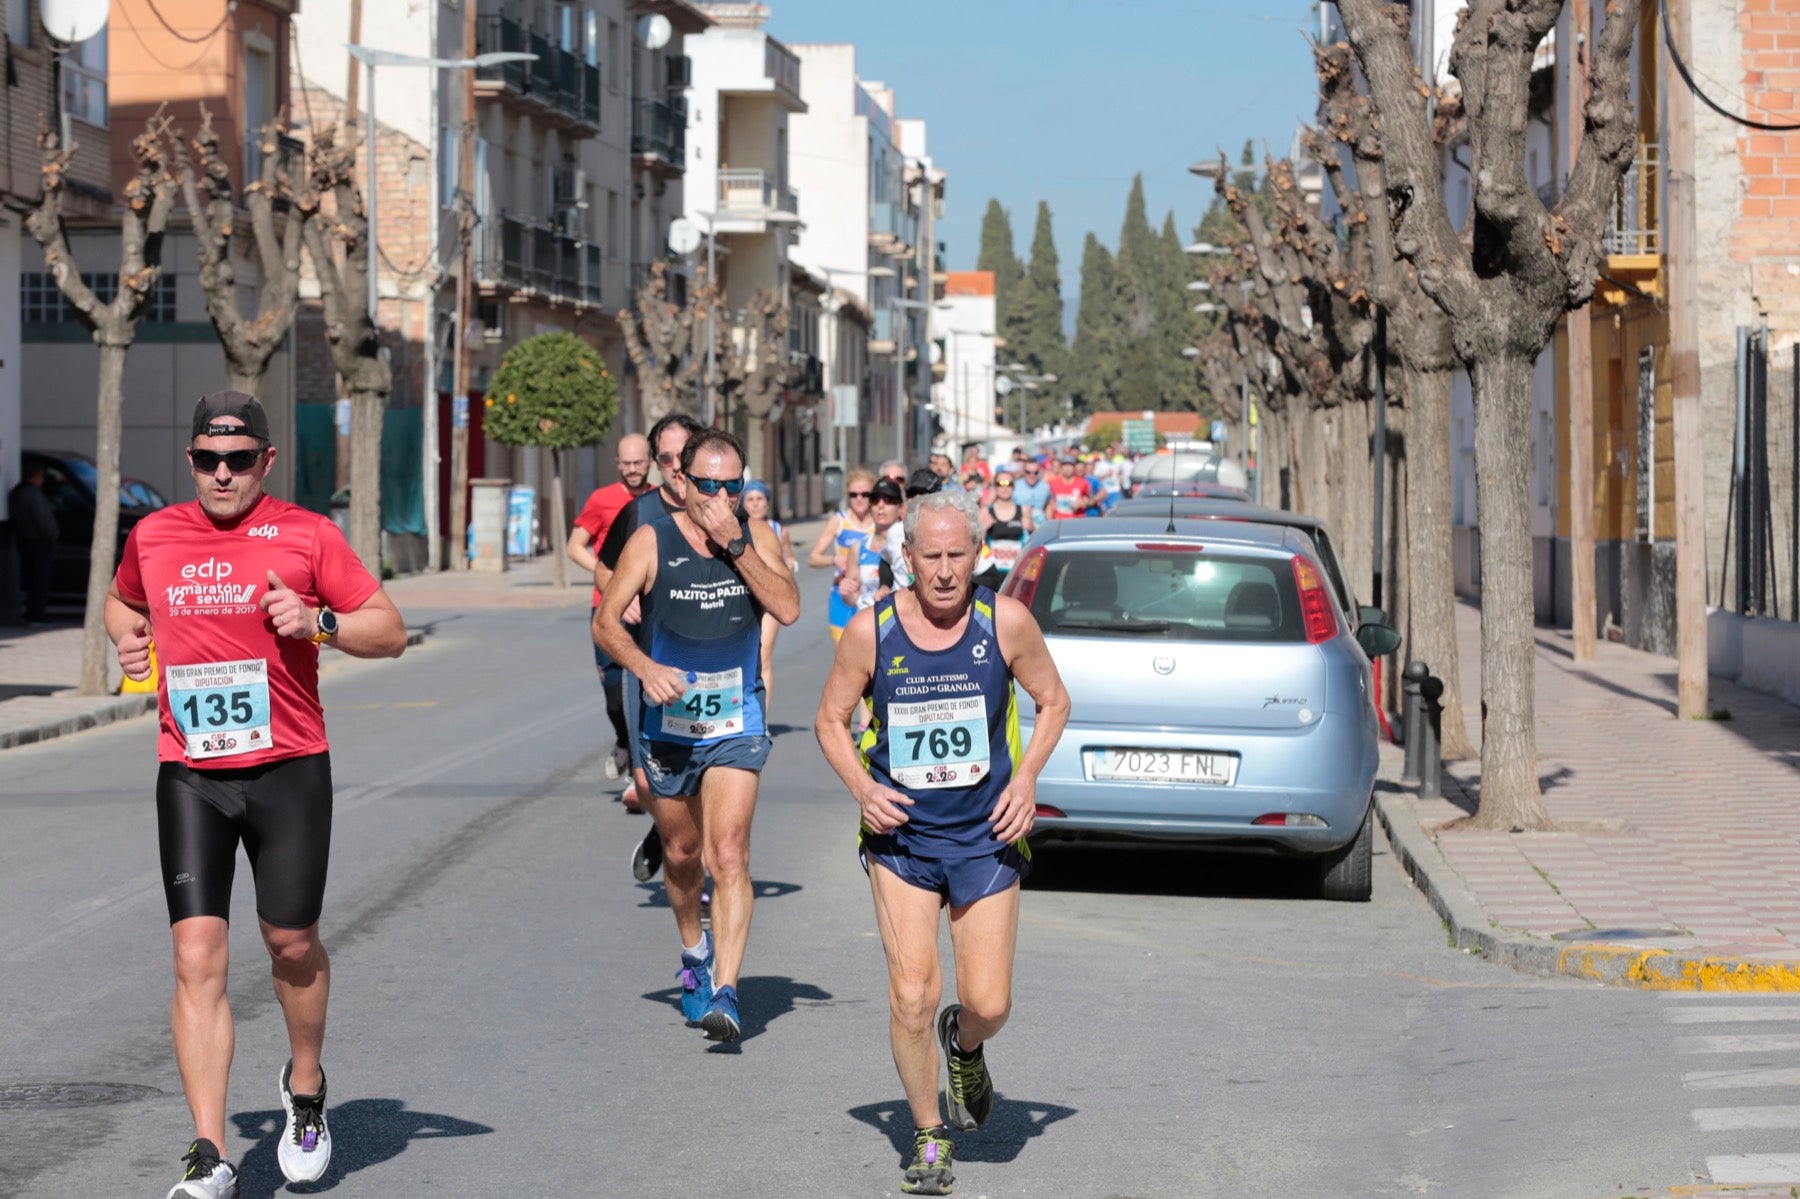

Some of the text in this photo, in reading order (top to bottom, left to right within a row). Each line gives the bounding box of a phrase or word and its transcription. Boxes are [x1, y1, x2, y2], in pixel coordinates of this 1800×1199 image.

[248, 523, 279, 540] edp
[181, 557, 233, 581] edp
[183, 582, 242, 595] maratón
[670, 589, 708, 601] PAZITO
[708, 592, 716, 600] a
[196, 590, 242, 605] sevilla
[700, 600, 725, 610] Motril
[181, 607, 192, 616] de
[194, 608, 219, 616] enero
[222, 606, 233, 615] de
[235, 606, 257, 615] 2017
[186, 667, 203, 677] GRAN
[203, 666, 228, 676] PREMIO
[229, 665, 237, 674] DE
[239, 663, 261, 673] FONDO
[906, 673, 969, 685] CLUB ATLETISMO
[895, 684, 930, 696] CIUDAD
[937, 682, 981, 693] GRANADA
[183, 691, 254, 729] 135
[685, 693, 722, 718] 45
[910, 704, 927, 714] GRAN
[927, 702, 950, 712] PREMIO
[950, 700, 959, 710] DE
[959, 699, 979, 709] FONDO
[905, 726, 972, 761] 769
[1114, 752, 1223, 777] 7023 FNL
